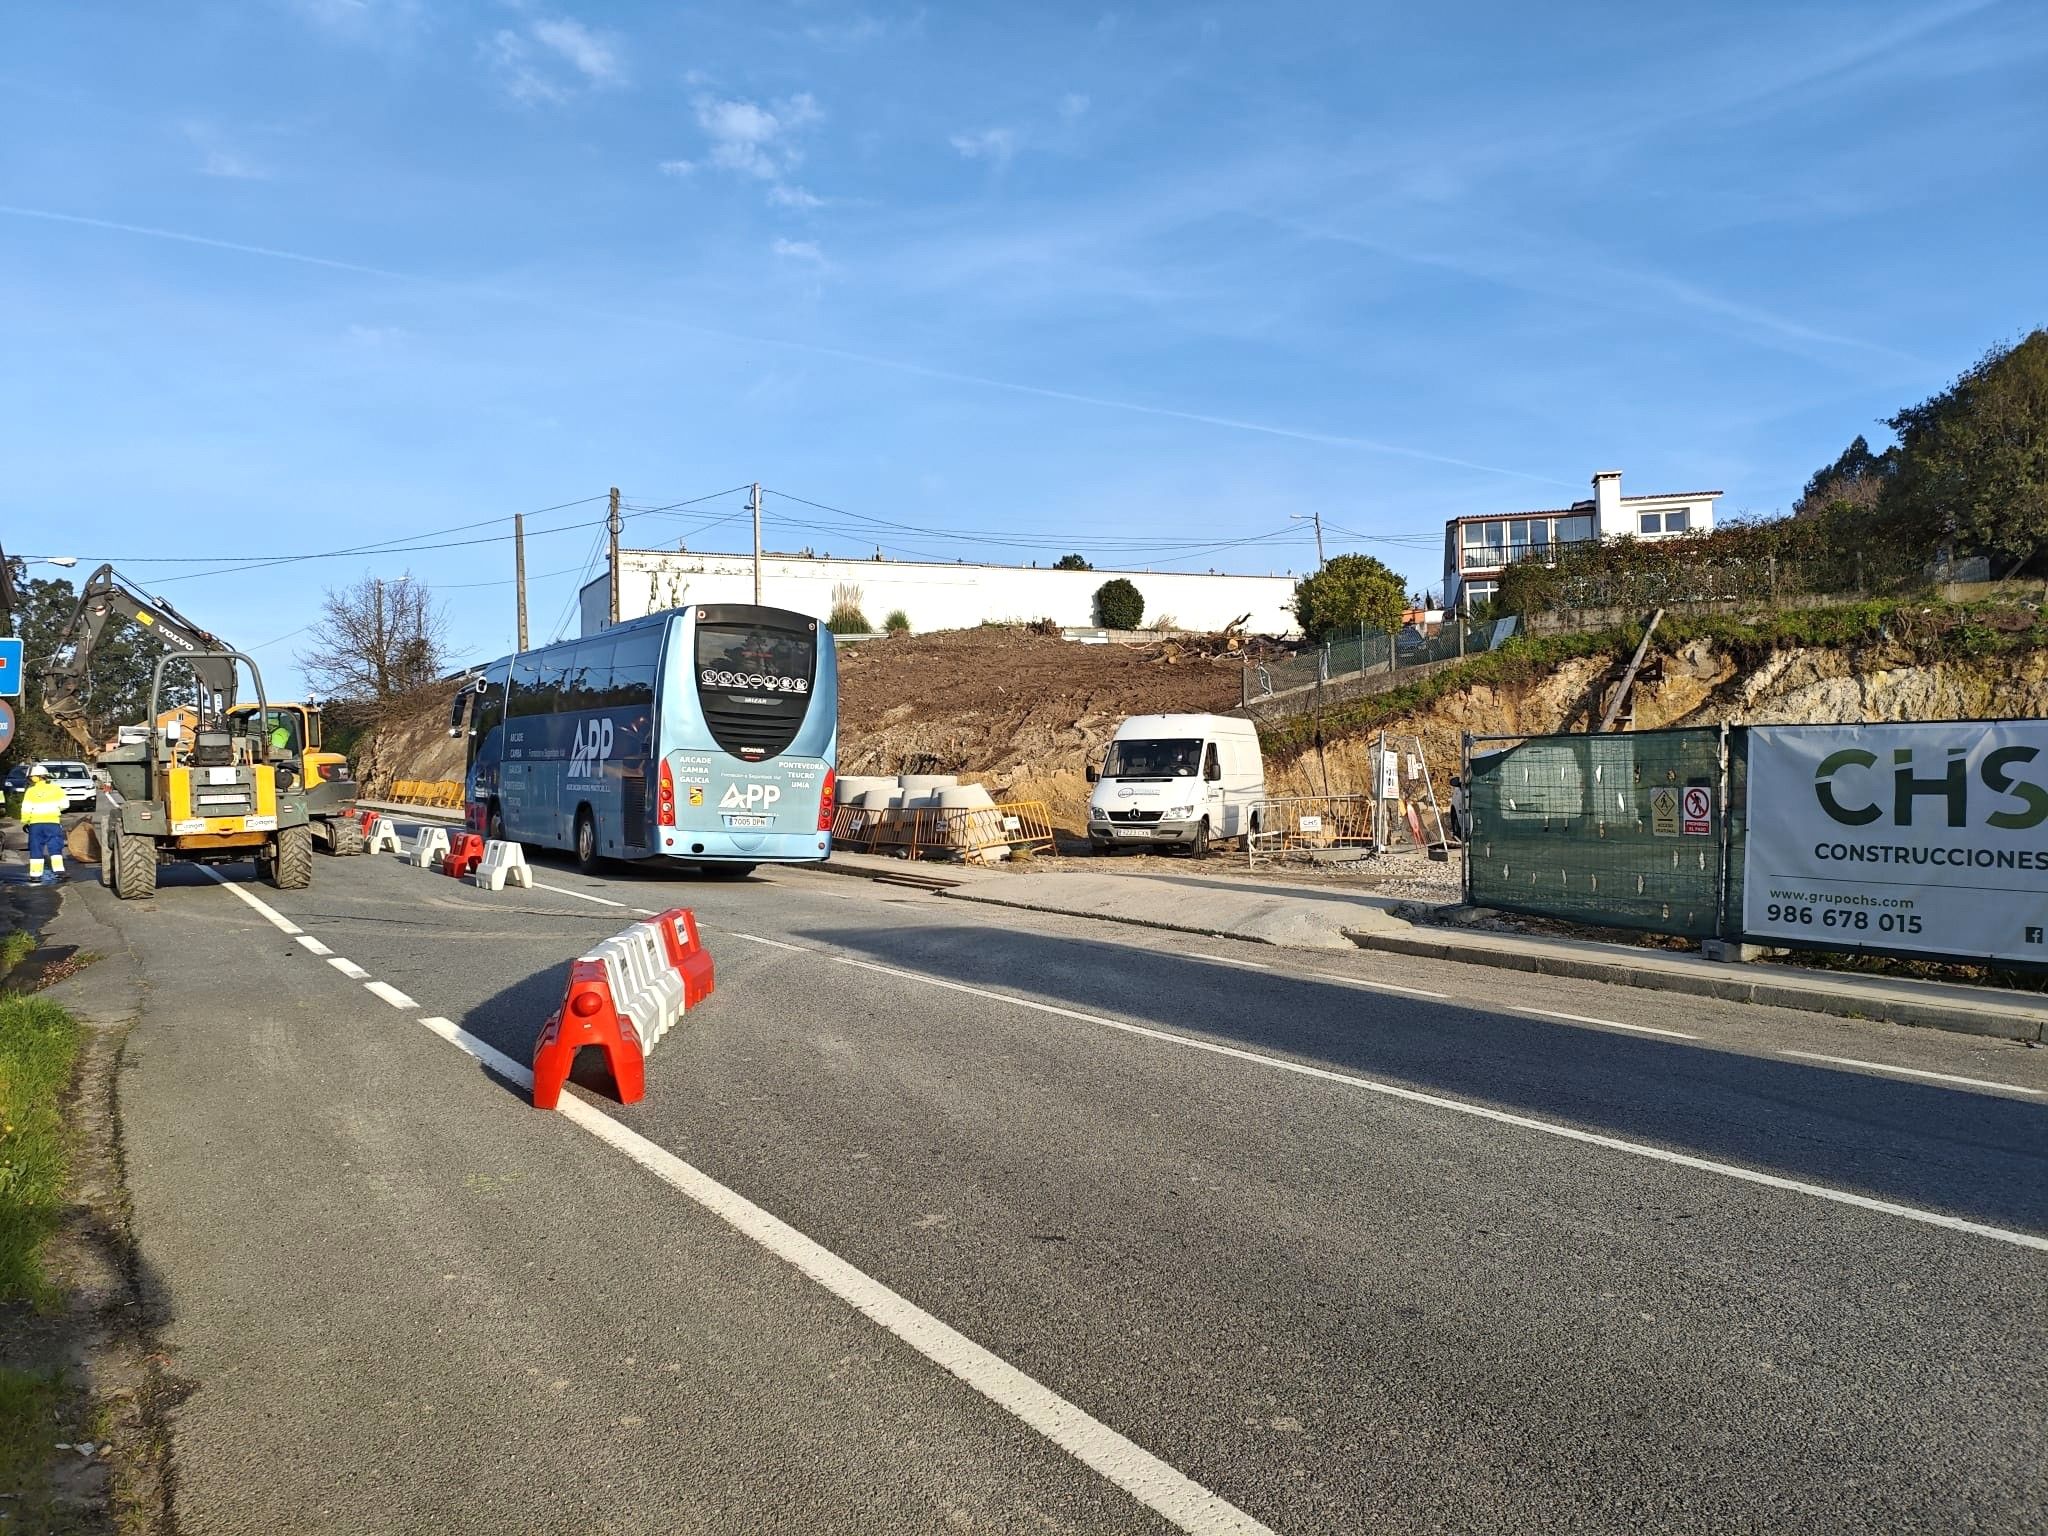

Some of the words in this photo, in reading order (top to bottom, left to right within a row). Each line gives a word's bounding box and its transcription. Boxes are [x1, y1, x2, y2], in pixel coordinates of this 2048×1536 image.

[158, 624, 194, 651] VOLVO
[567, 718, 614, 778] APP
[740, 746, 765, 754] SCANIA
[679, 756, 712, 764] ARCADE
[778, 761, 824, 770] PONTEVEDRA
[681, 766, 709, 774] CAMBA
[679, 776, 710, 784] GALICIA
[791, 781, 810, 789] UMIA
[1814, 745, 2048, 830] CHS
[718, 782, 781, 810] APP
[733, 817, 751, 826] 7005
[752, 817, 766, 826] DPN
[1814, 842, 2048, 870] CONSTRUCCIONES
[1769, 888, 1914, 909] www.grupochs.com
[1767, 904, 1813, 924] 986
[1822, 908, 1868, 930] 678
[1878, 913, 1923, 934] 015
